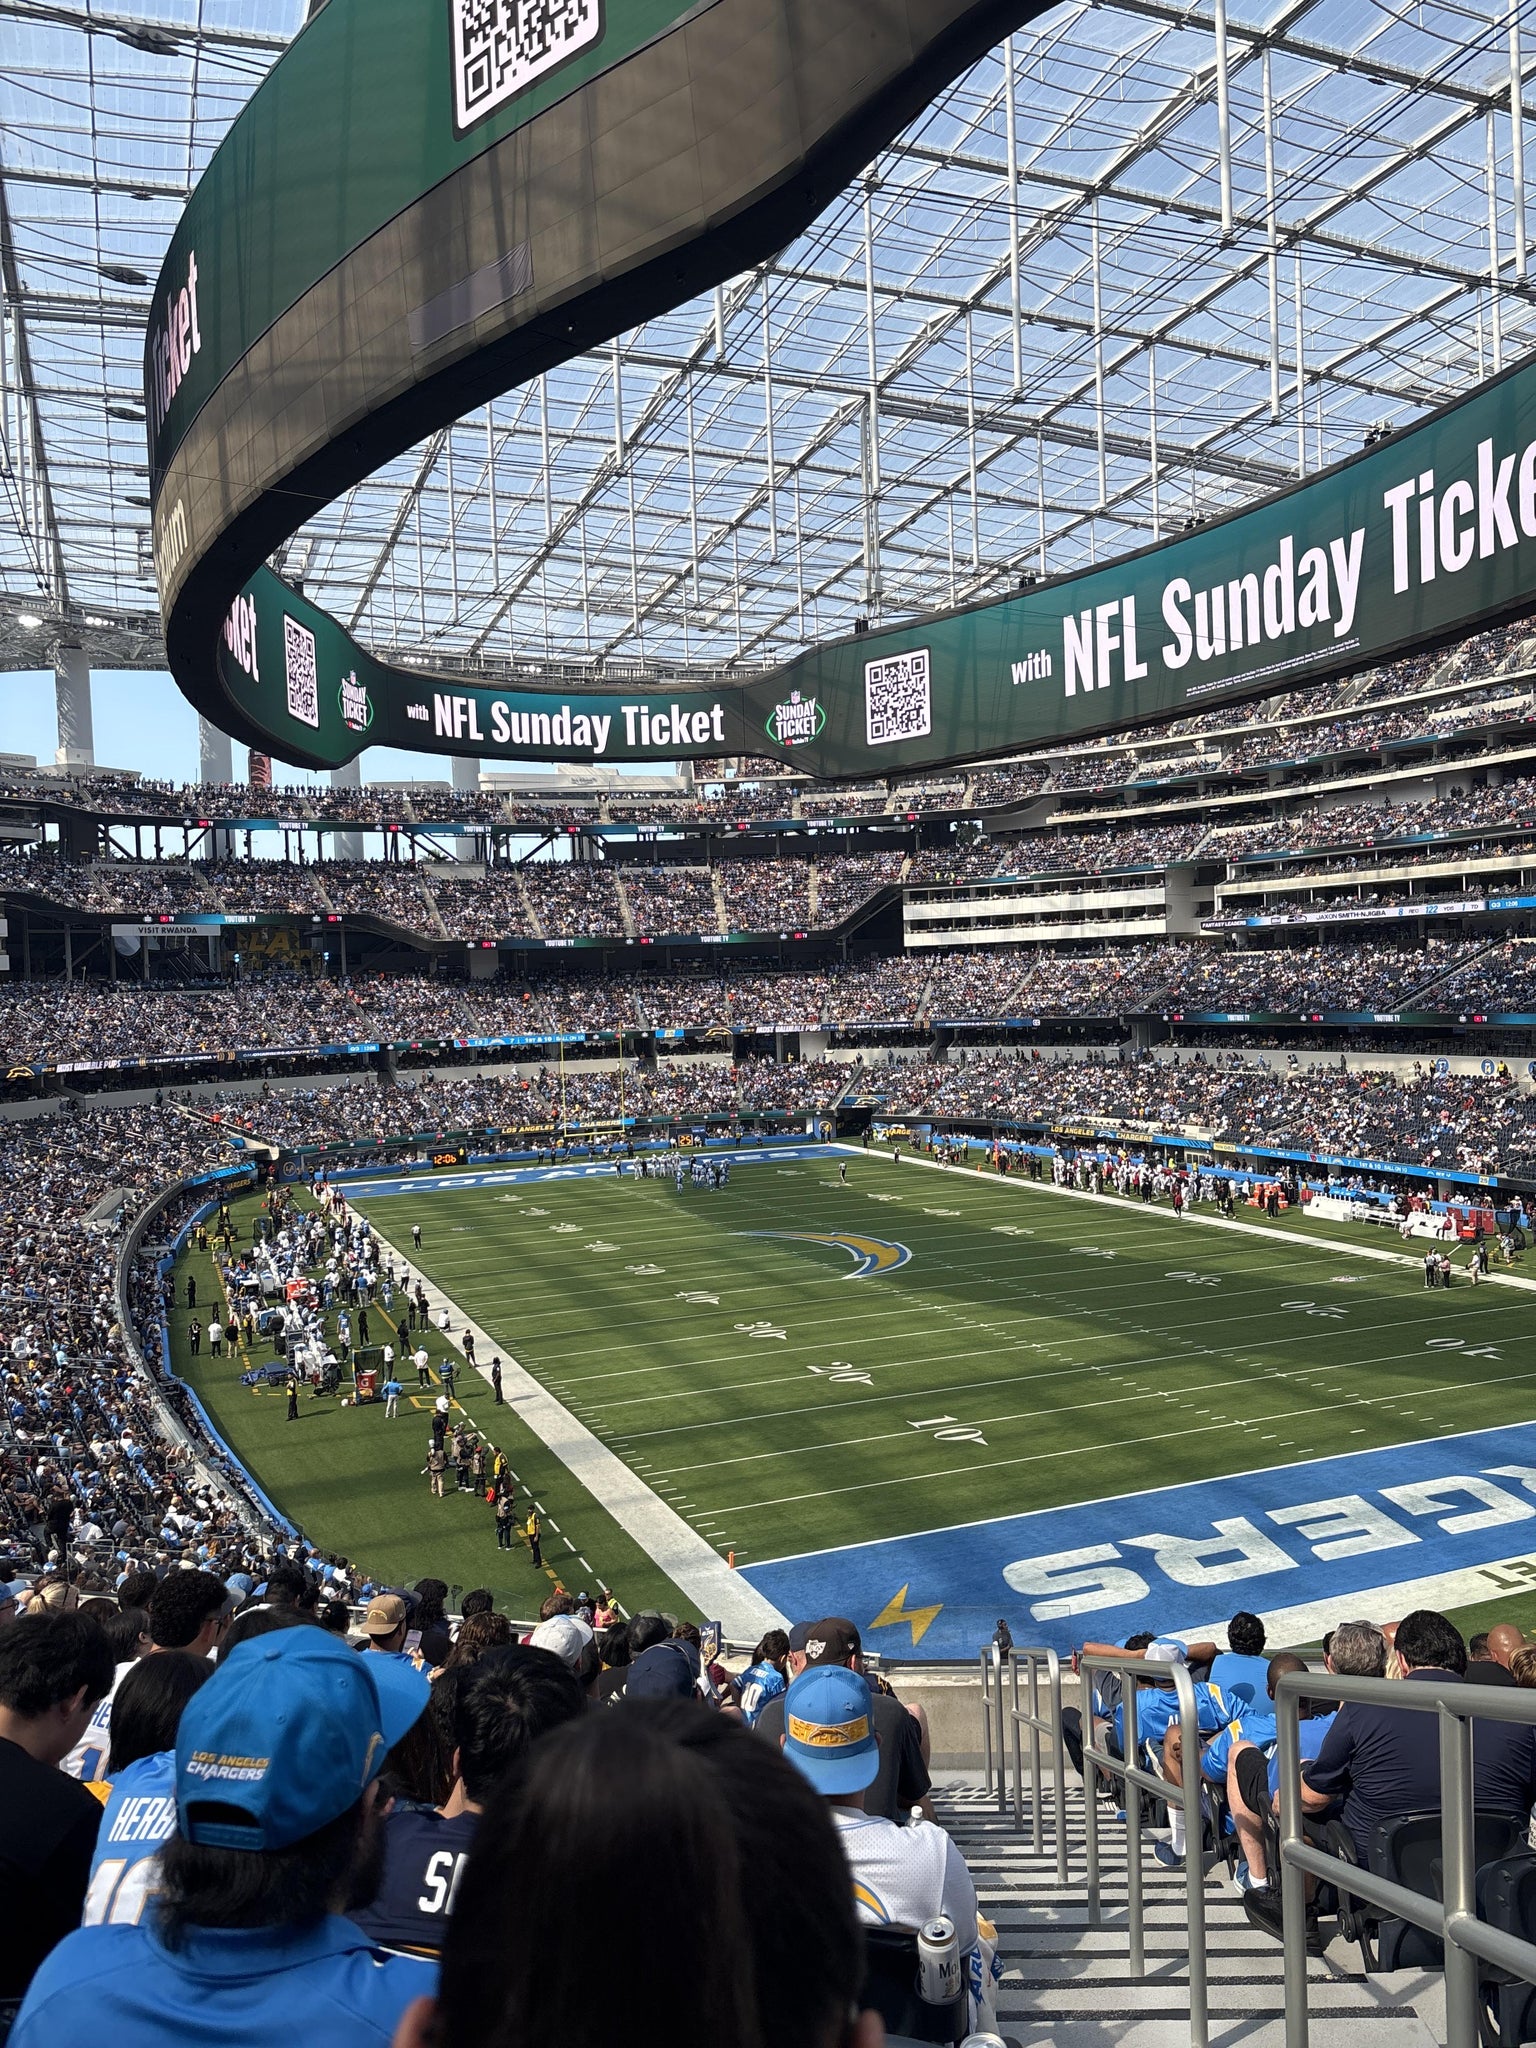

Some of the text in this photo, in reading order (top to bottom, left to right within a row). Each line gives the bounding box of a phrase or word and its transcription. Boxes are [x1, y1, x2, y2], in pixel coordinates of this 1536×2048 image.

[1011, 649, 1052, 685] with
[1062, 594, 1148, 697] NFL
[1161, 527, 1366, 670] Sunday
[775, 697, 816, 722] SUNDAY
[406, 693, 725, 754] with NFL Sunday Ticket
[776, 716, 817, 741] TICKET
[1316, 913, 1338, 921] JAXON
[1338, 910, 1386, 919] SMITH-NJIGBA
[1398, 907, 1404, 916] 8
[1425, 905, 1438, 914] 122
[138, 926, 198, 934] VISIT RWANDA
[1374, 1014, 1400, 1022] YOUTUBE TV
[755, 1025, 774, 1033] MOST
[805, 1023, 821, 1031] PUPS
[56, 1063, 73, 1073] MOST
[103, 1059, 121, 1069] PUPS
[502, 1119, 621, 1134] LOS ANGELES CHARGERS
[1051, 1125, 1153, 1143] LOS ANGELES CHARGERS
[680, 1136, 691, 1145] 25
[433, 1153, 457, 1165] 12:06
[399, 1174, 517, 1190] LOS
[1164, 1271, 1222, 1286] 30
[1280, 1300, 1348, 1317] 20
[733, 1321, 787, 1339] 30
[1425, 1338, 1502, 1359] 10
[806, 1361, 871, 1383] 20
[361, 1378, 369, 1387] G
[906, 1415, 983, 1442] 10
[741, 1682, 765, 1712] 10
[192, 1750, 271, 1768] LOS ANGELES
[186, 1760, 267, 1782] CHARGERS
[939, 1961, 960, 1979] Mo
